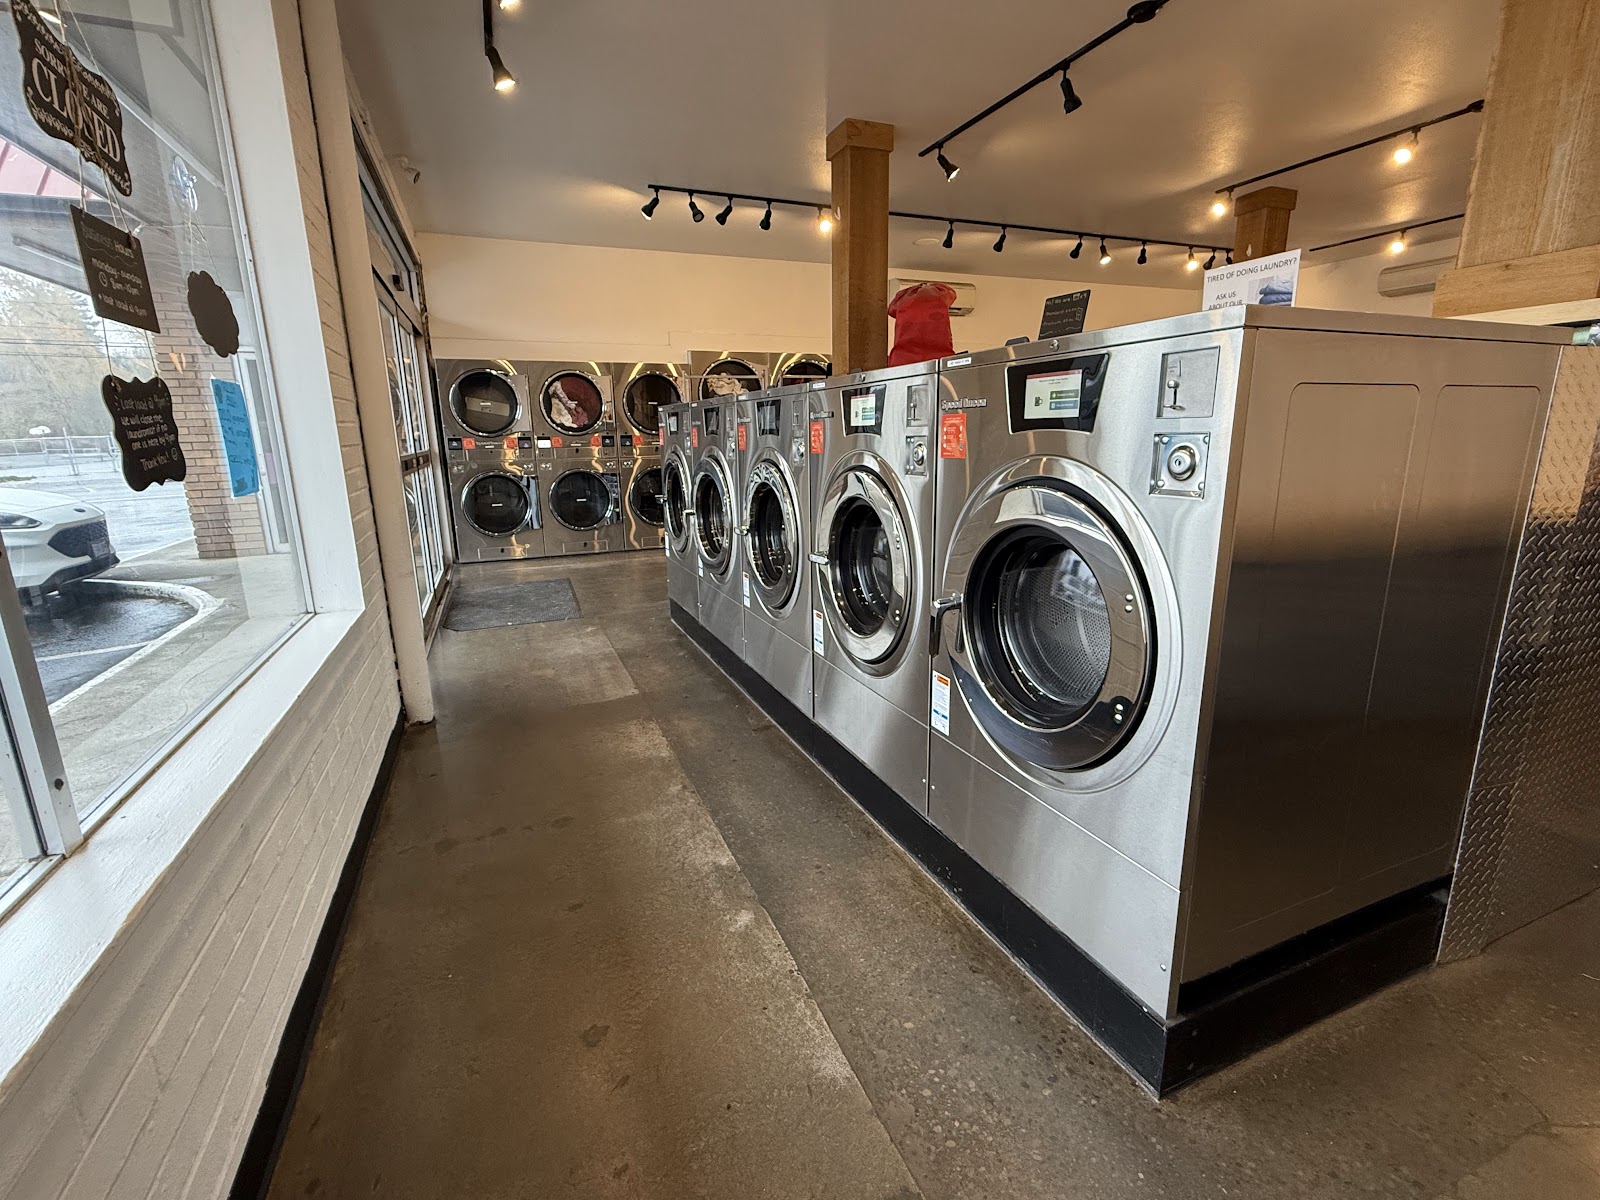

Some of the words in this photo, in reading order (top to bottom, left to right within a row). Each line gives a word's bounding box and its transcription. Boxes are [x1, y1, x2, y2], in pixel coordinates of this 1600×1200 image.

[32, 57, 121, 163] CLOSED
[91, 93, 110, 120] ARE
[114, 240, 134, 259] HOURS
[1207, 273, 1225, 283] TIRED
[1226, 270, 1235, 280] OF
[1236, 266, 1259, 277] DOING
[1260, 257, 1298, 272] LAUNDRY?
[1215, 293, 1227, 301] ASK
[1208, 301, 1228, 310] ABOUT
[120, 397, 135, 410] Last
[135, 398, 148, 410] load
[941, 399, 963, 412] Speed
[963, 397, 987, 408] Queen
[140, 414, 153, 425] close
[126, 425, 156, 439] laundromat
[161, 423, 168, 432] no
[131, 441, 142, 451] one
[148, 437, 159, 447] here
[140, 457, 158, 471] Thank
